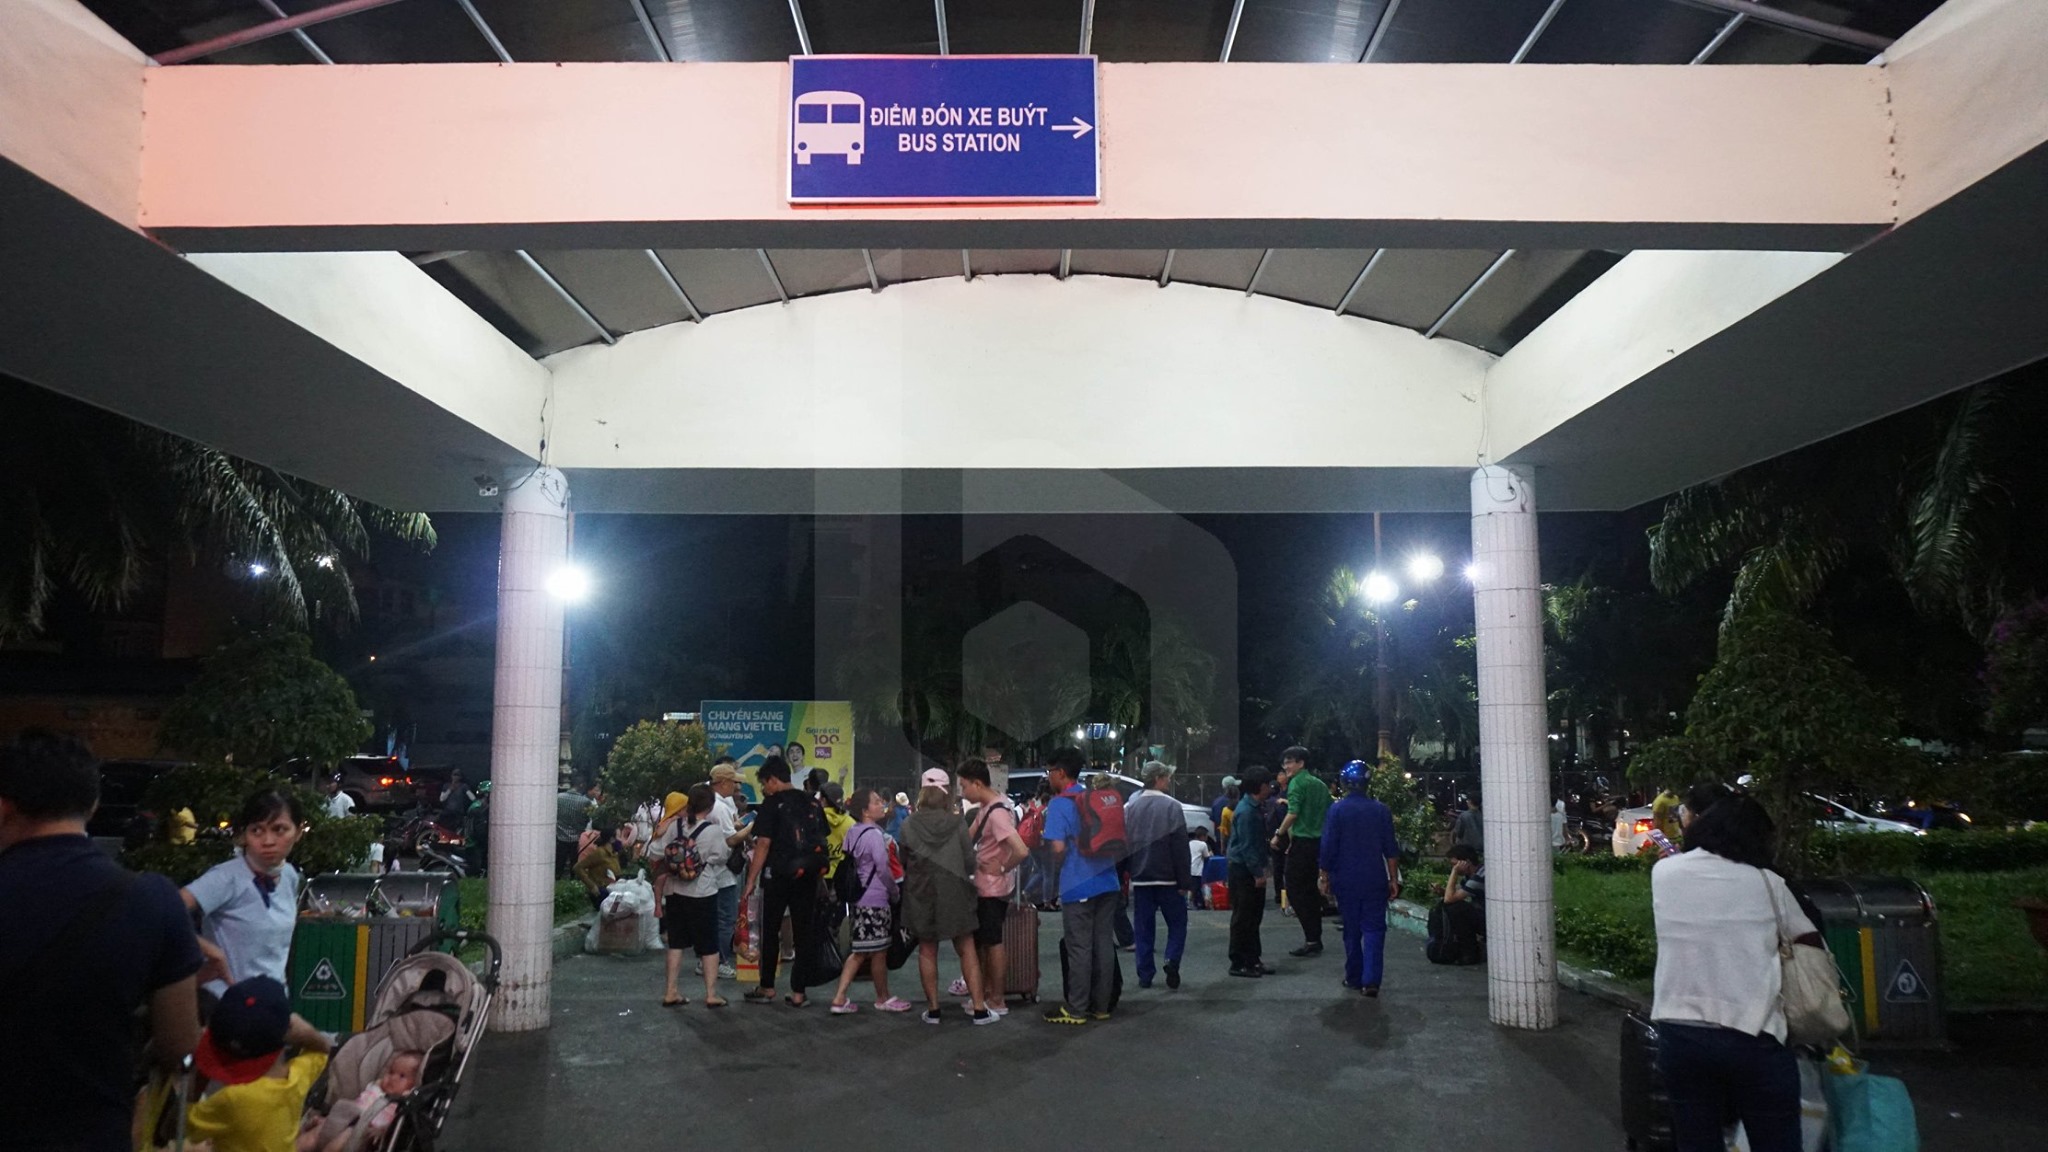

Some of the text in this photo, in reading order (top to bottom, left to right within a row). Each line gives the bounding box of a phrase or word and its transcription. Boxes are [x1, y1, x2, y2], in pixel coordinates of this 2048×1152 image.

[870, 102, 1048, 126] ĐIỂM ĐÓN XE BUÝT
[898, 133, 1020, 152] BUS STATION
[752, 711, 784, 720] SANG
[742, 721, 786, 731] VIETTEL
[813, 734, 840, 745] 100
